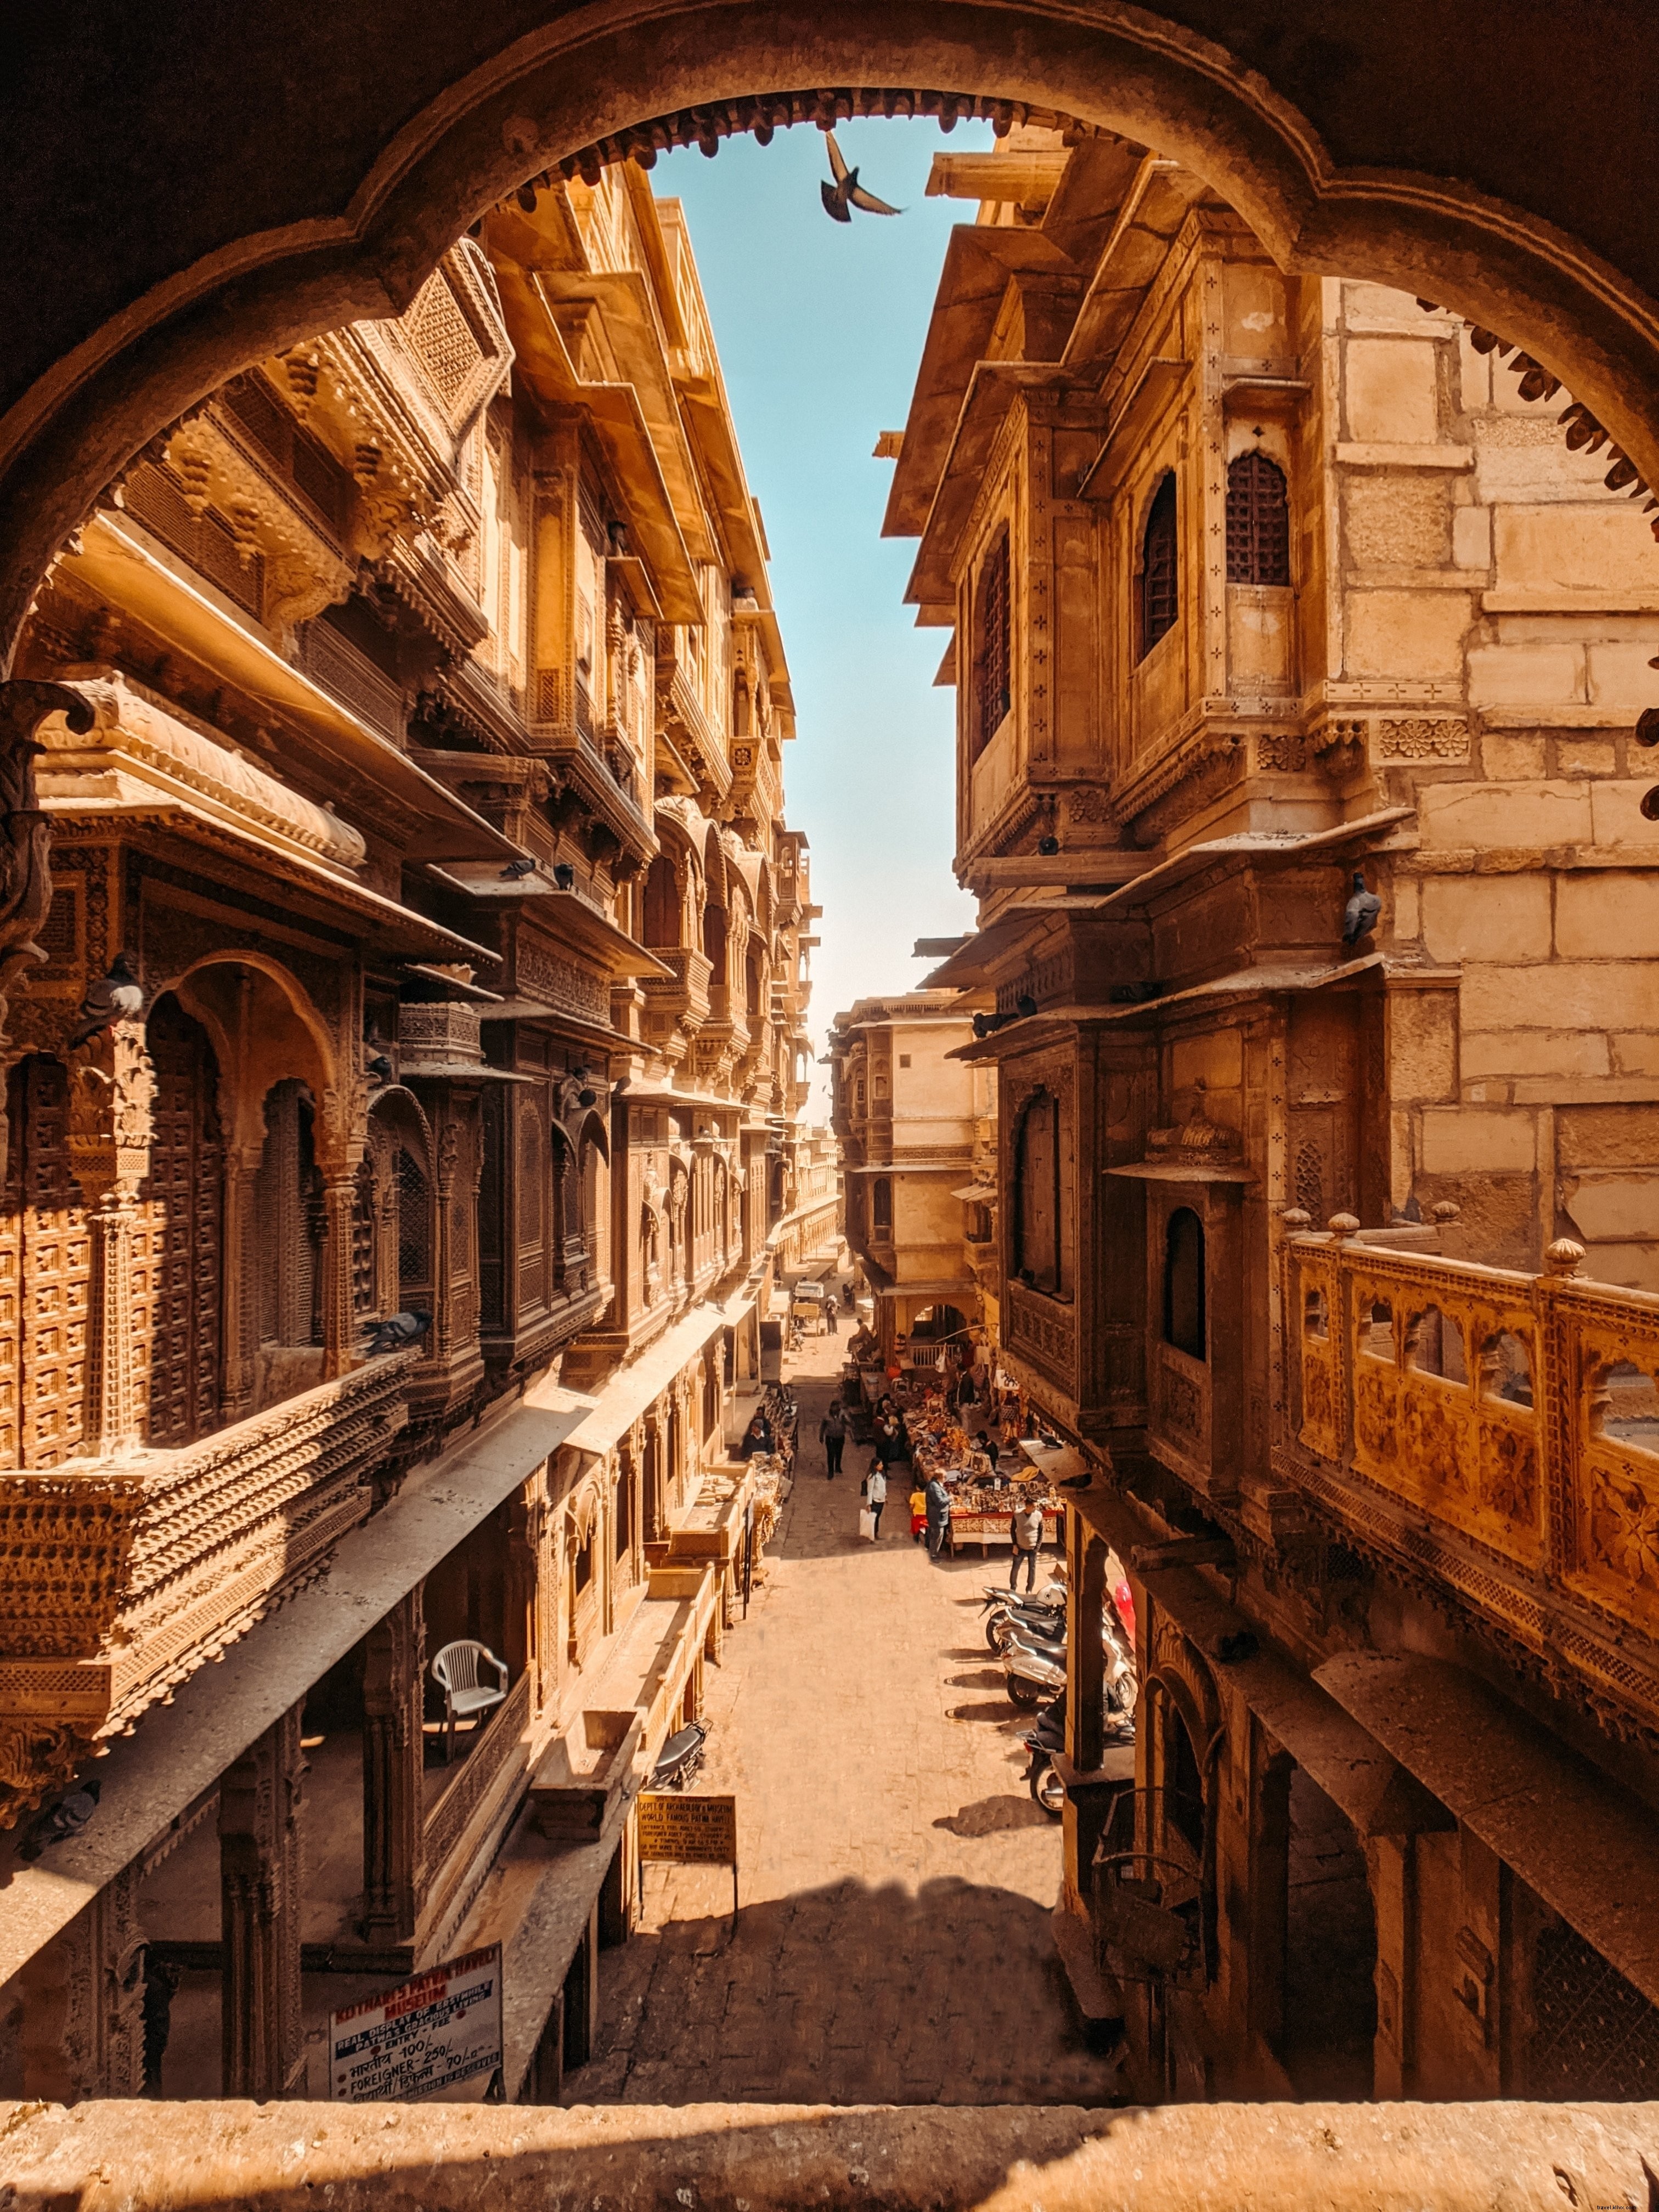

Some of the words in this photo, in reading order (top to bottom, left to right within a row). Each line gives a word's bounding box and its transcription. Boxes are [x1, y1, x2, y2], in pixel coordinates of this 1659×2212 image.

[641, 1813, 663, 1822] WORLD
[337, 2033, 365, 2051] REAL
[369, 2014, 411, 2038] DISPLAY
[416, 2008, 430, 2019] OF
[436, 1979, 490, 2010] ERSTWHILE
[385, 1984, 446, 2022] MUSEUM
[405, 2008, 450, 2033] GRACIOUS
[453, 1994, 485, 2011] LIVING
[385, 2029, 419, 2050] ENTRY
[432, 2018, 450, 2030] FEE
[349, 2052, 393, 2078] भारतीय
[424, 2038, 453, 2064] 250/-
